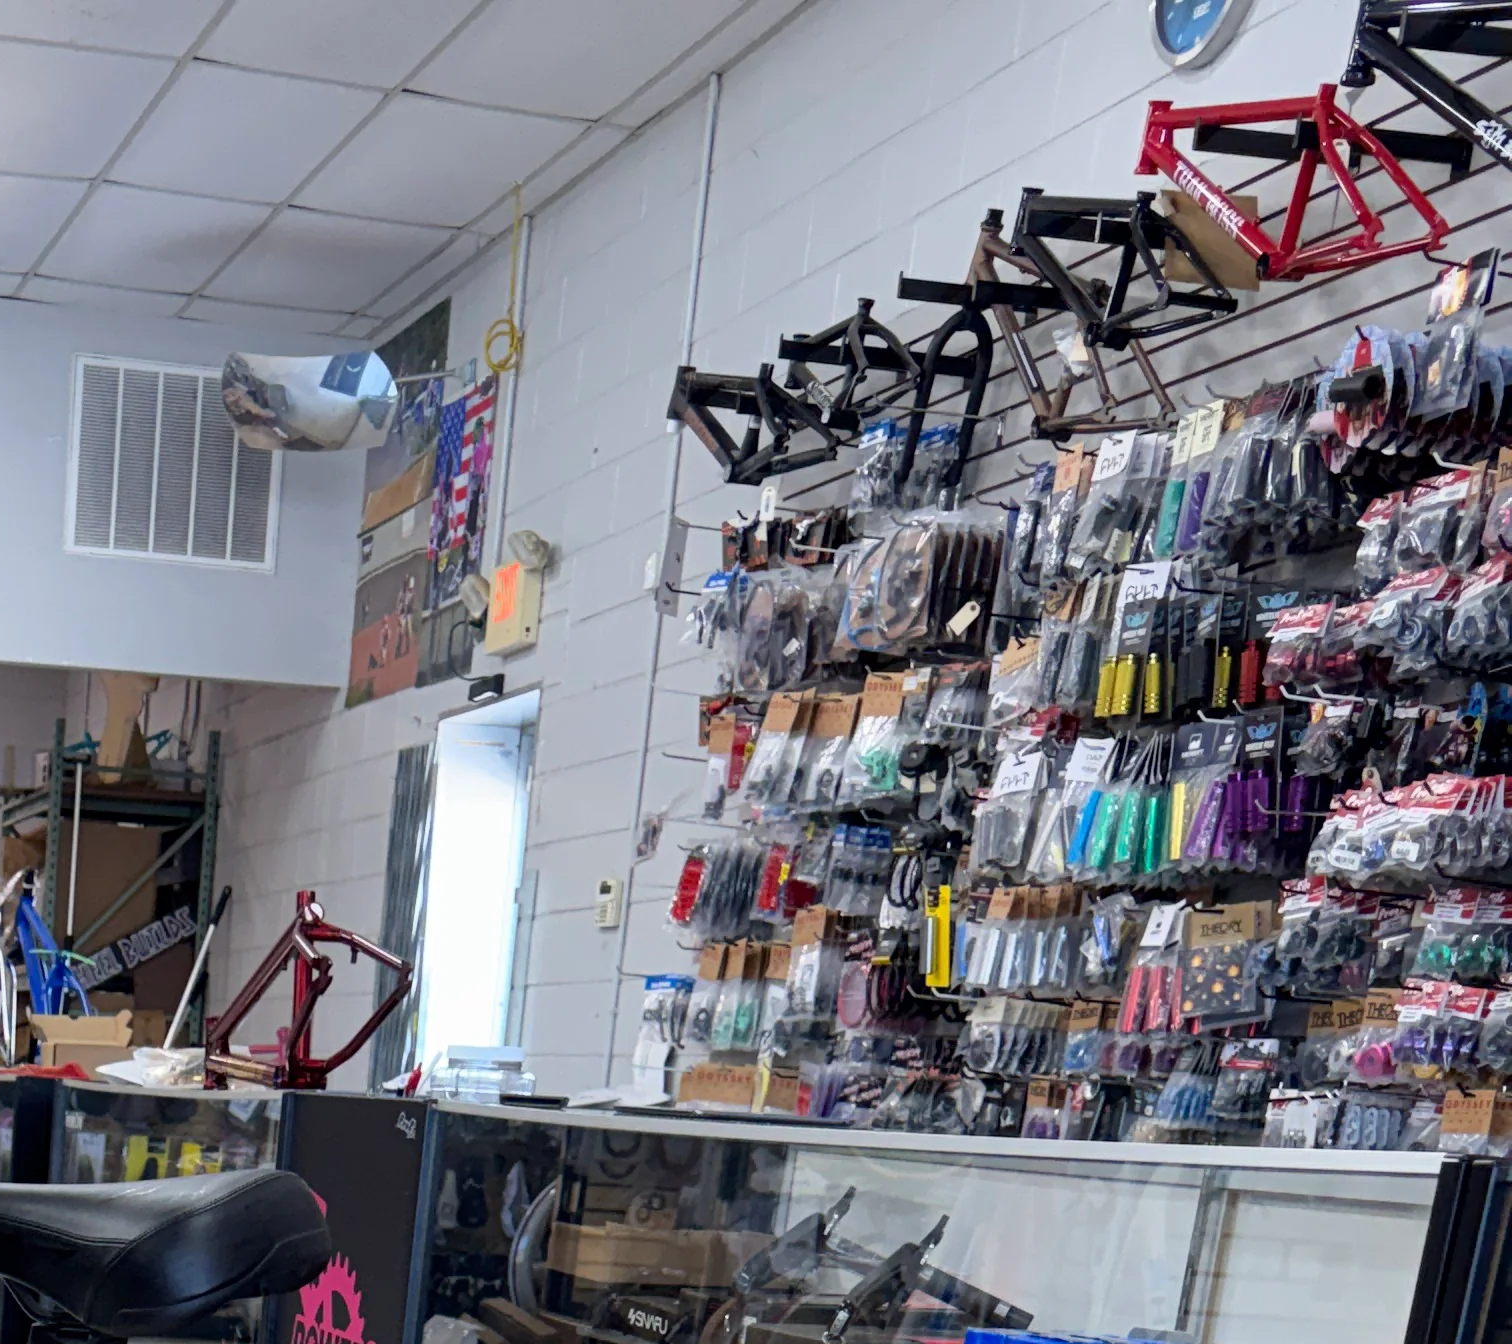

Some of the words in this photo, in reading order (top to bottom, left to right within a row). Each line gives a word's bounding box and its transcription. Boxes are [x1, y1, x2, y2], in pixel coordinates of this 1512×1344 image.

[117, 905, 199, 969] BUILDS
[1199, 919, 1243, 938] THEORY
[1445, 1100, 1492, 1110] ODYSSEY
[634, 1309, 669, 1336] SNAFU
